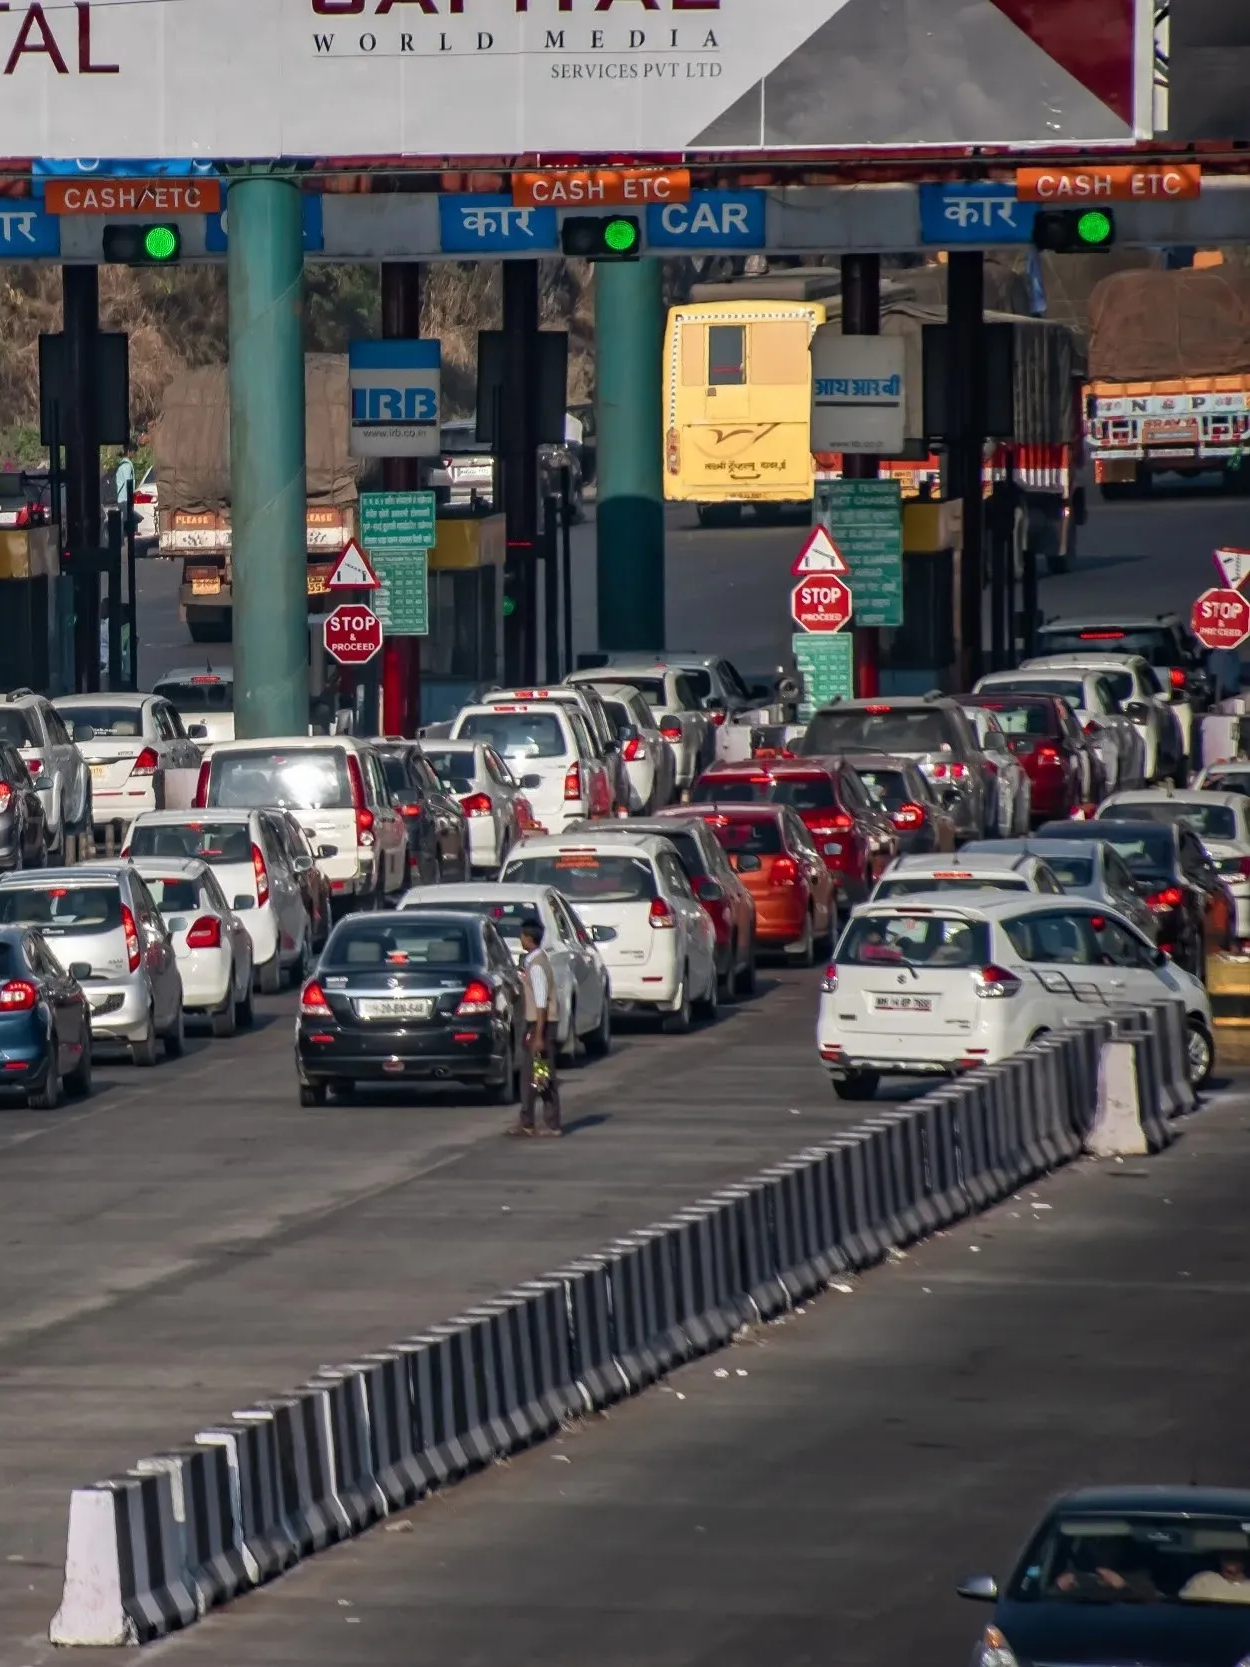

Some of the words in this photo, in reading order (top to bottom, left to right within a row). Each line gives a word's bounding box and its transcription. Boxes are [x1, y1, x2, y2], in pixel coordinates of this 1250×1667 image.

[312, 32, 494, 52] WORLD
[545, 29, 719, 49] MEDIA
[550, 63, 638, 78] SERVICES
[643, 63, 680, 78] PVT
[686, 62, 722, 77] LTD
[532, 180, 605, 201] CASH
[623, 178, 670, 199] ETC
[1037, 175, 1111, 197] CASH
[1131, 173, 1181, 194] ETC
[64, 188, 135, 209] CASH
[155, 187, 200, 208] ETC
[461, 207, 535, 236] कार
[662, 203, 749, 234] CAR
[943, 197, 1018, 228] कार
[352, 388, 437, 418] IRB
[801, 587, 841, 604] STOP
[1201, 601, 1243, 618] STOP
[330, 616, 377, 631] STOP
[331, 642, 375, 651] PROCEED
[350, 633, 356, 641] &
